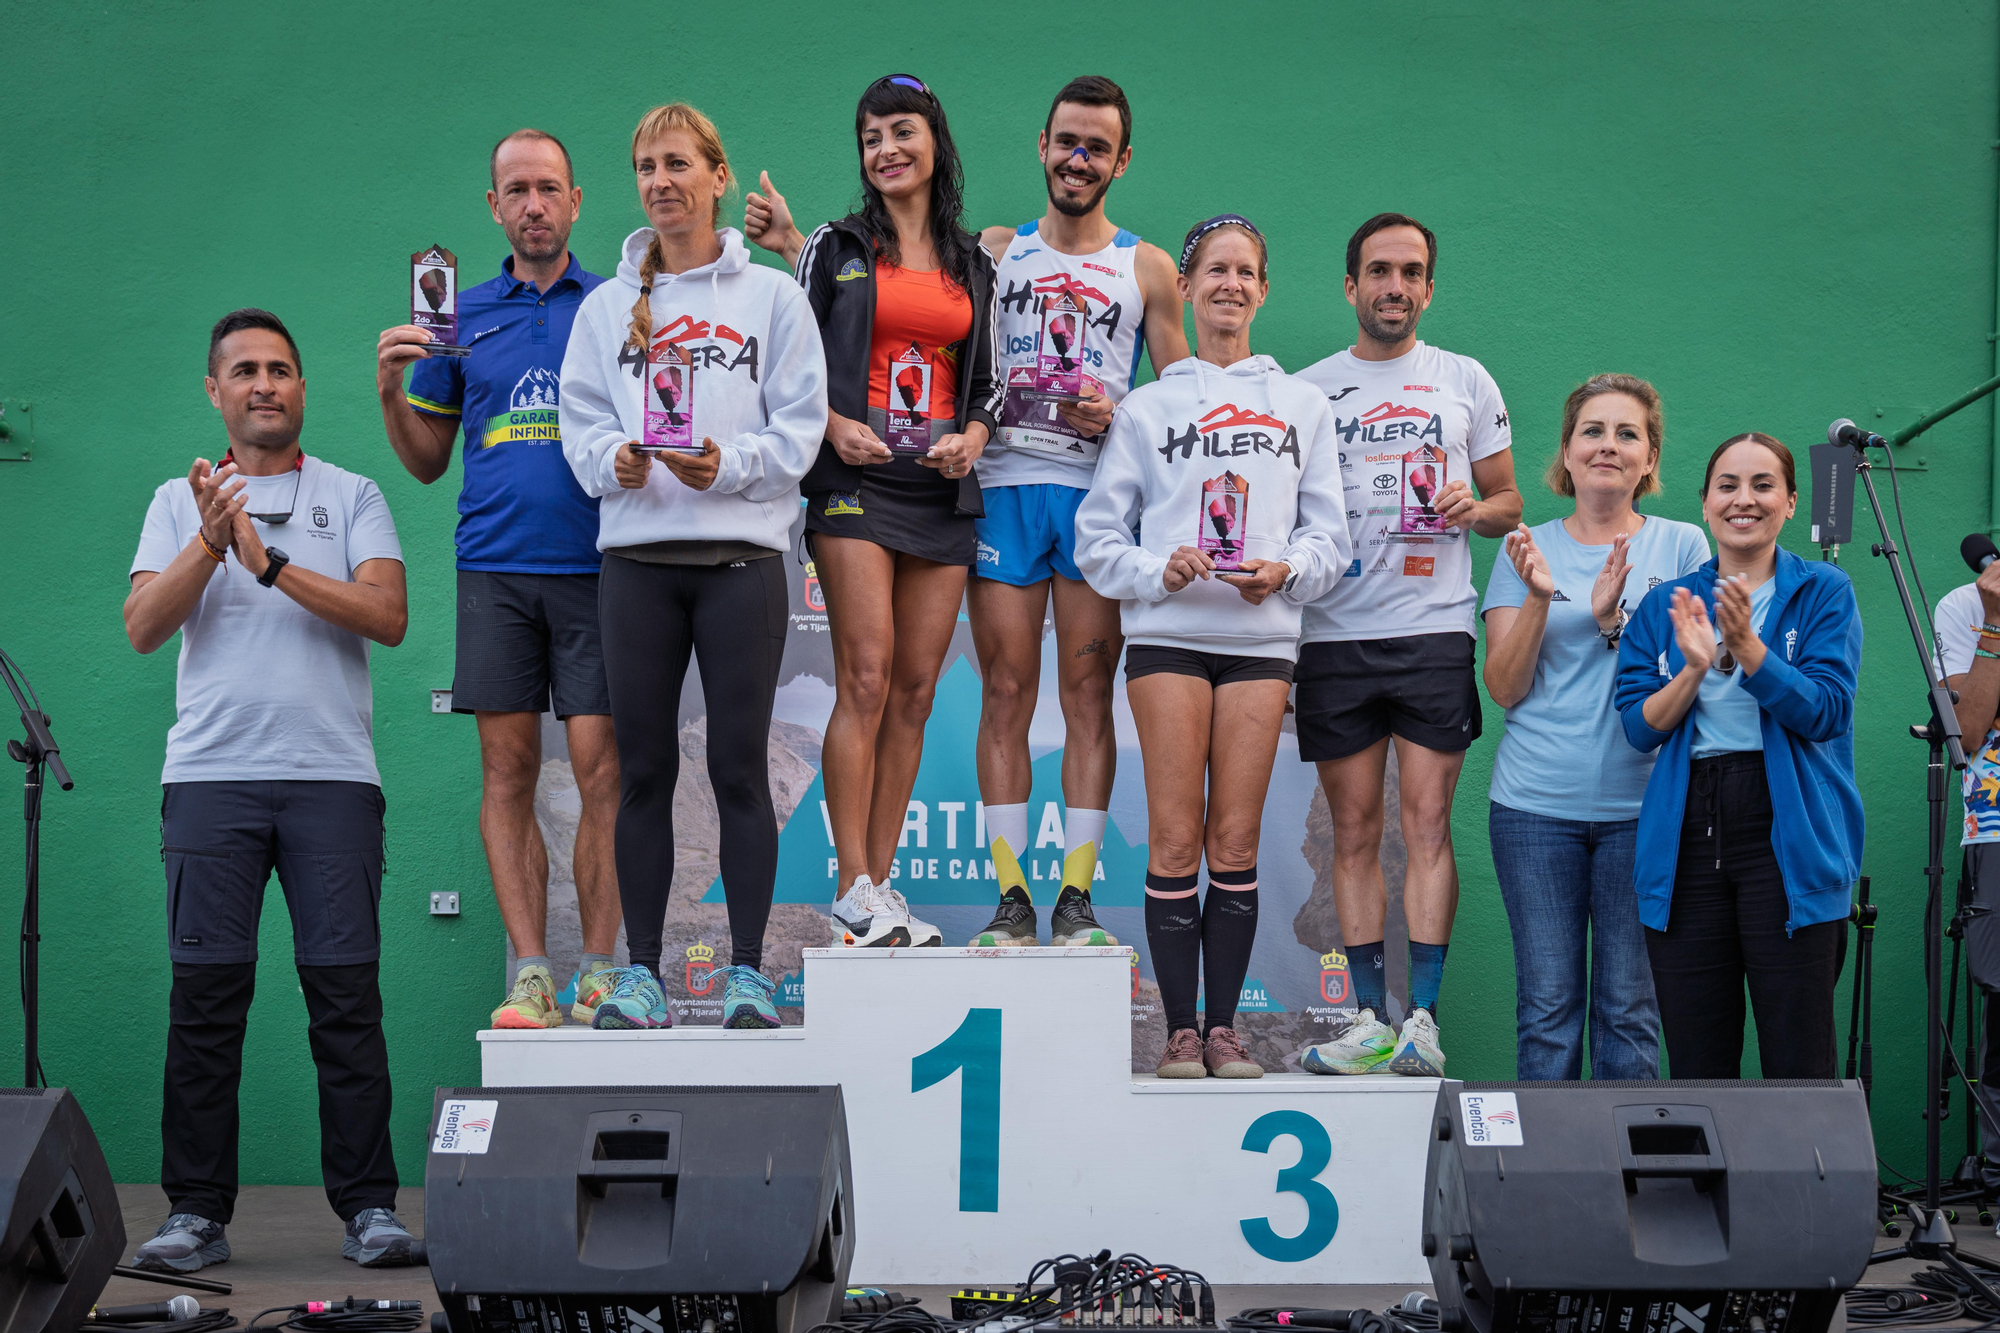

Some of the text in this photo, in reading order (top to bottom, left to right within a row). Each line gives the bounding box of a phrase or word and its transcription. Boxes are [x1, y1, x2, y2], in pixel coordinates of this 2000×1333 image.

[1090, 265, 1116, 275] SPAR
[414, 314, 430, 323] 2do
[1006, 331, 1103, 367] loslos
[1040, 359, 1056, 370] 1er
[646, 415, 664, 424] 2da
[889, 413, 911, 425] 1era
[1335, 413, 1443, 446] HILERA
[1158, 422, 1301, 470] HILERA
[977, 551, 1000, 566] ERA
[911, 859, 938, 879] DE
[671, 999, 724, 1007] Ayuntamient
[1306, 1006, 1359, 1015] Ayuntamient
[691, 1008, 722, 1017] Tijarafe
[1326, 1015, 1352, 1024] Tijara
[911, 1007, 1002, 1212] 1
[441, 1105, 466, 1148] Eventos
[1467, 1097, 1485, 1142] Eventos
[1240, 1109, 1339, 1262] 3
[576, 1310, 592, 1333] FBT
[1619, 1307, 1634, 1331] FBT
